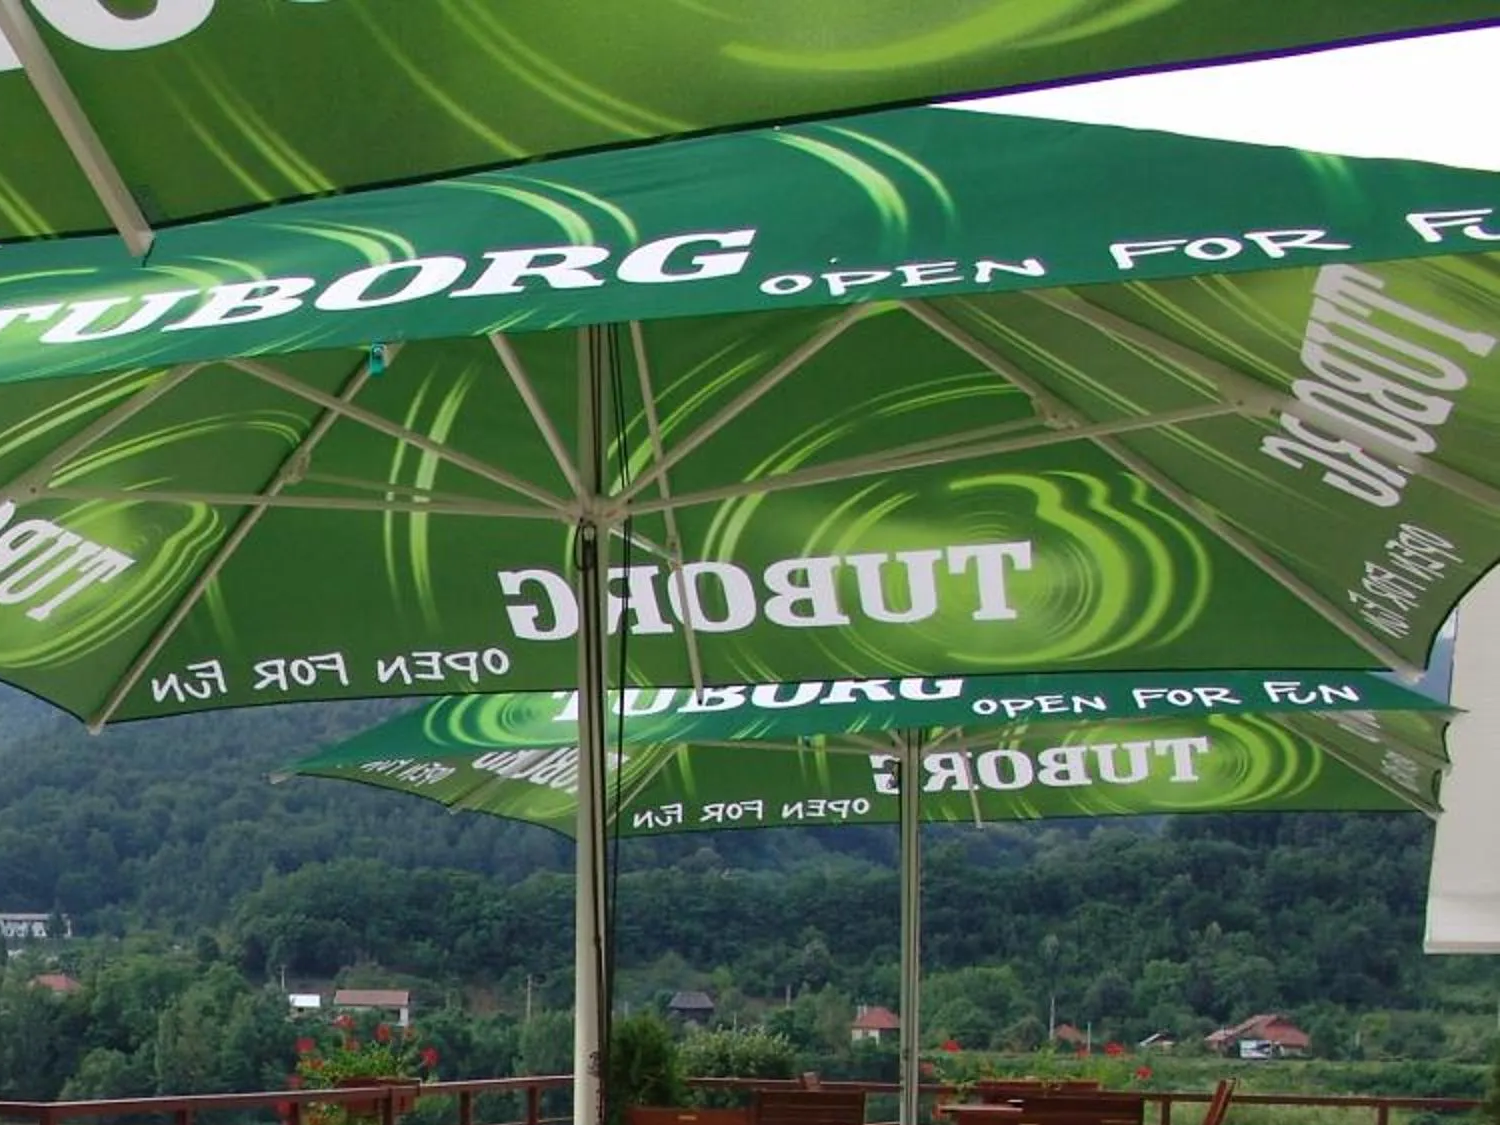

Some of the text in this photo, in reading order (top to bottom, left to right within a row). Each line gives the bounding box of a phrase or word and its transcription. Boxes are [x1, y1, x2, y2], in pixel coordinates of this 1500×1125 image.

[759, 257, 1046, 297] OPEN
[1108, 228, 1352, 270] FOR
[1405, 207, 1500, 243] FU
[971, 693, 1107, 718] OPEN
[1132, 686, 1242, 709] FOR
[1262, 680, 1361, 705] FUN
